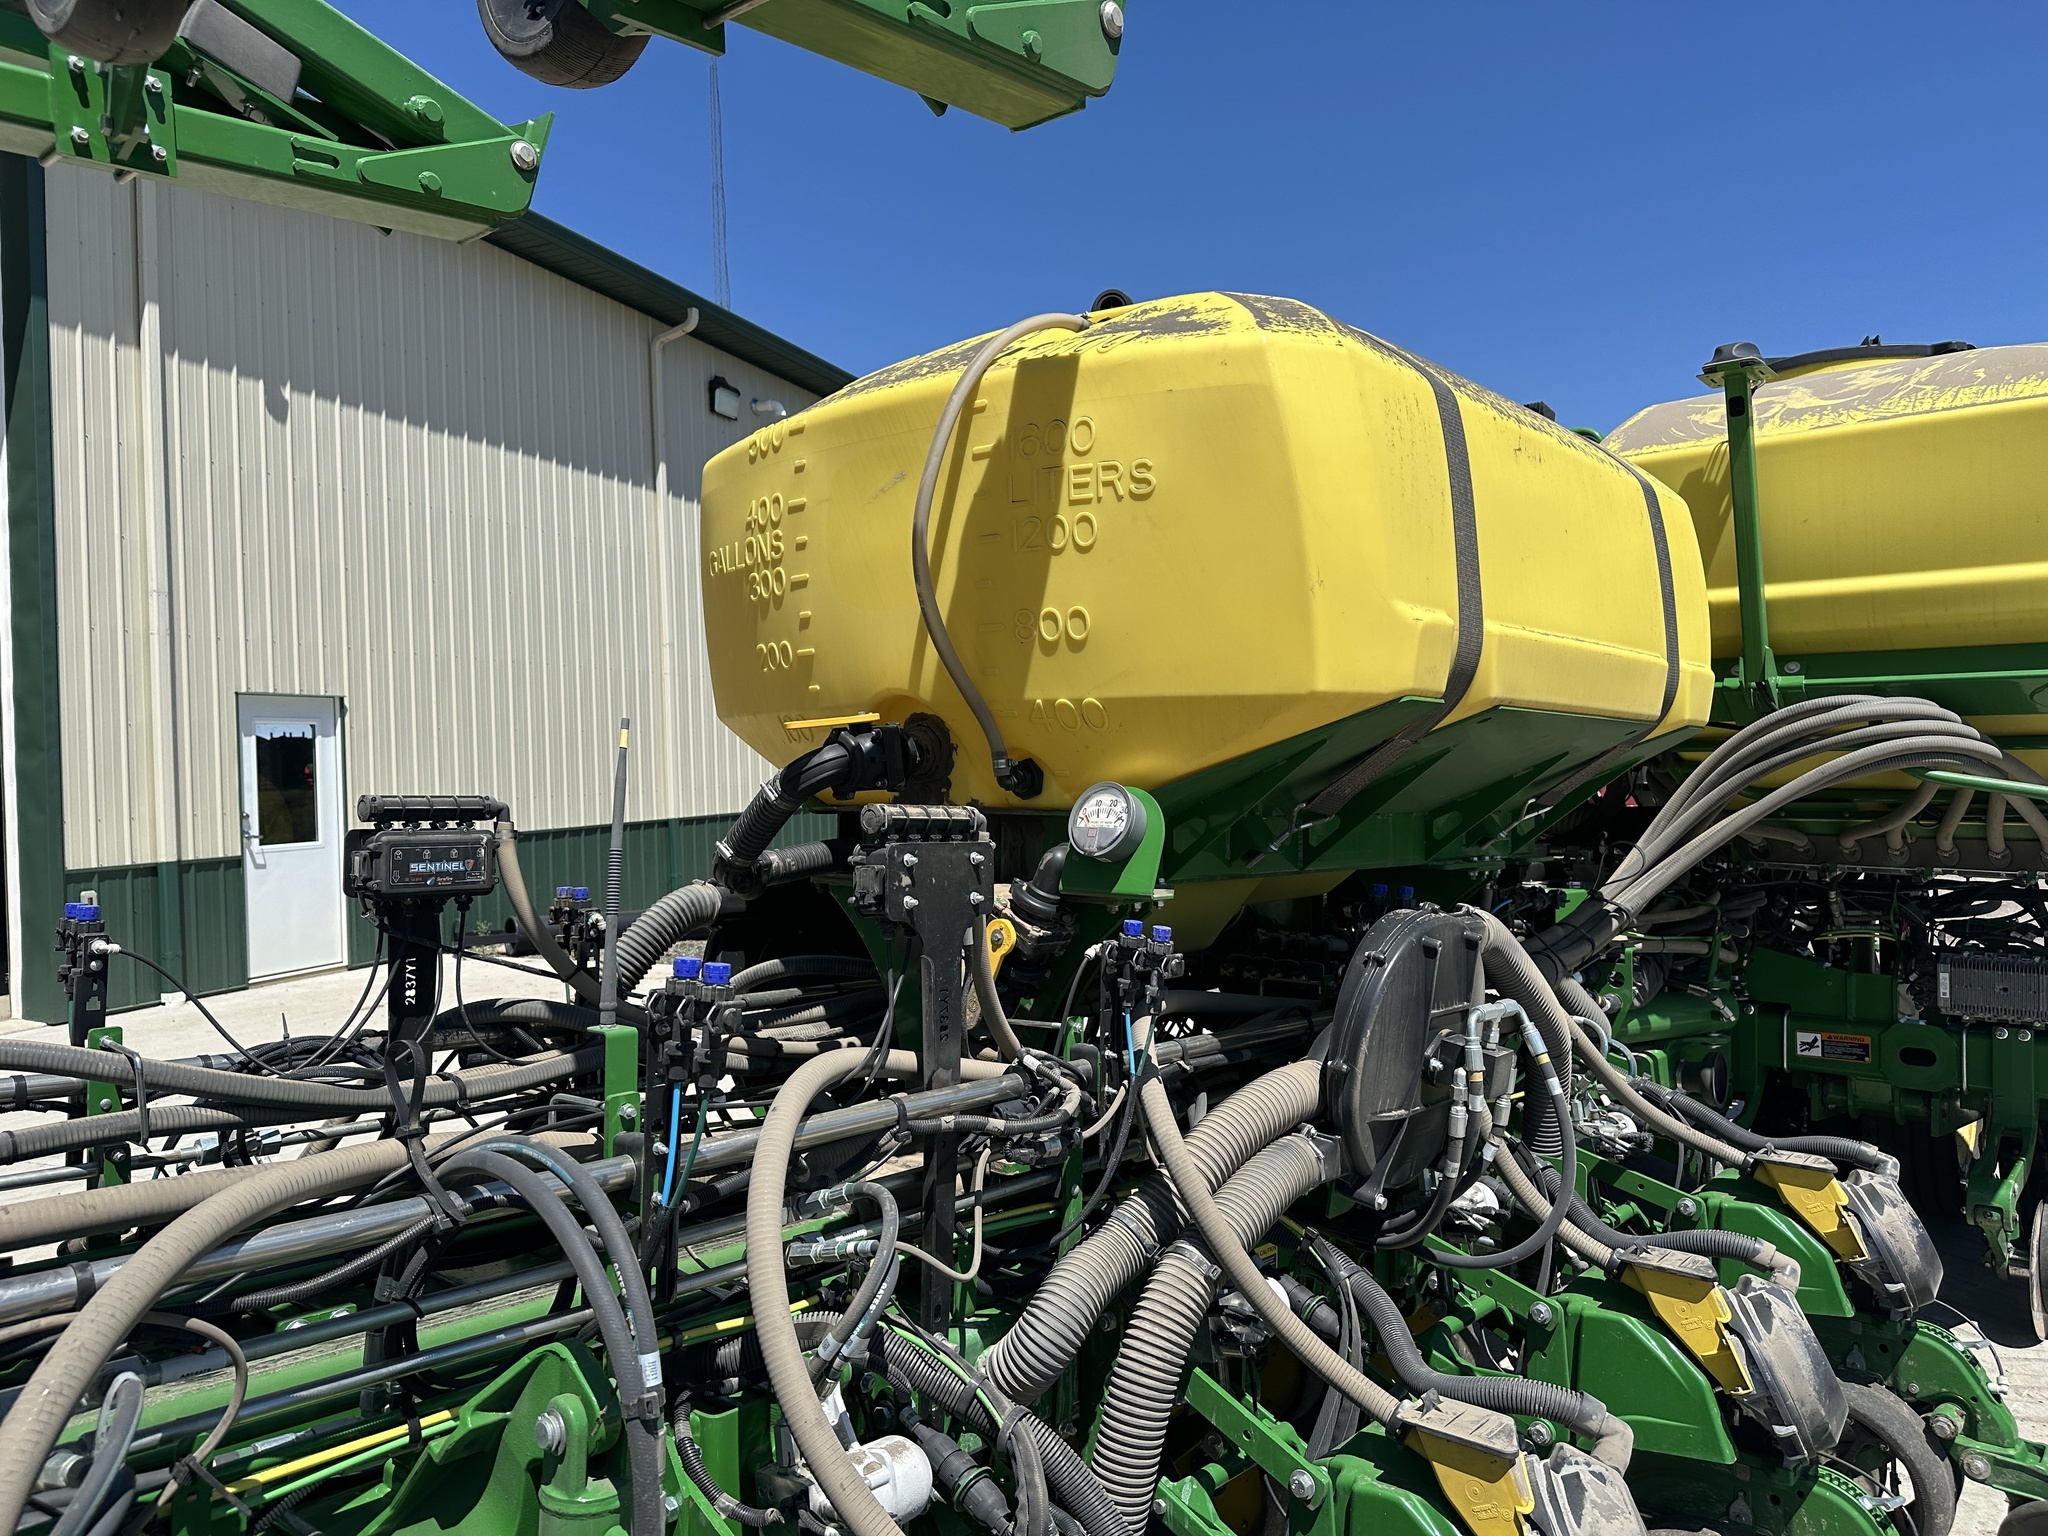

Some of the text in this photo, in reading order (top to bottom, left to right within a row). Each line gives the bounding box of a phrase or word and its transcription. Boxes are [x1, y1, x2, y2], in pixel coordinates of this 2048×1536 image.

[1008, 457, 1157, 509] LITERS
[746, 492, 783, 529] 400
[1010, 511, 1098, 553] 1200
[709, 529, 785, 577] GALLONS
[748, 566, 786, 601] 300
[1014, 605, 1091, 642] 800
[756, 640, 793, 672] 200
[1030, 697, 1109, 733] 400
[1095, 799, 1103, 807] 10
[1109, 799, 1119, 808] 20
[409, 860, 466, 874] SENTINEL
[869, 1282, 888, 1313] GATES
